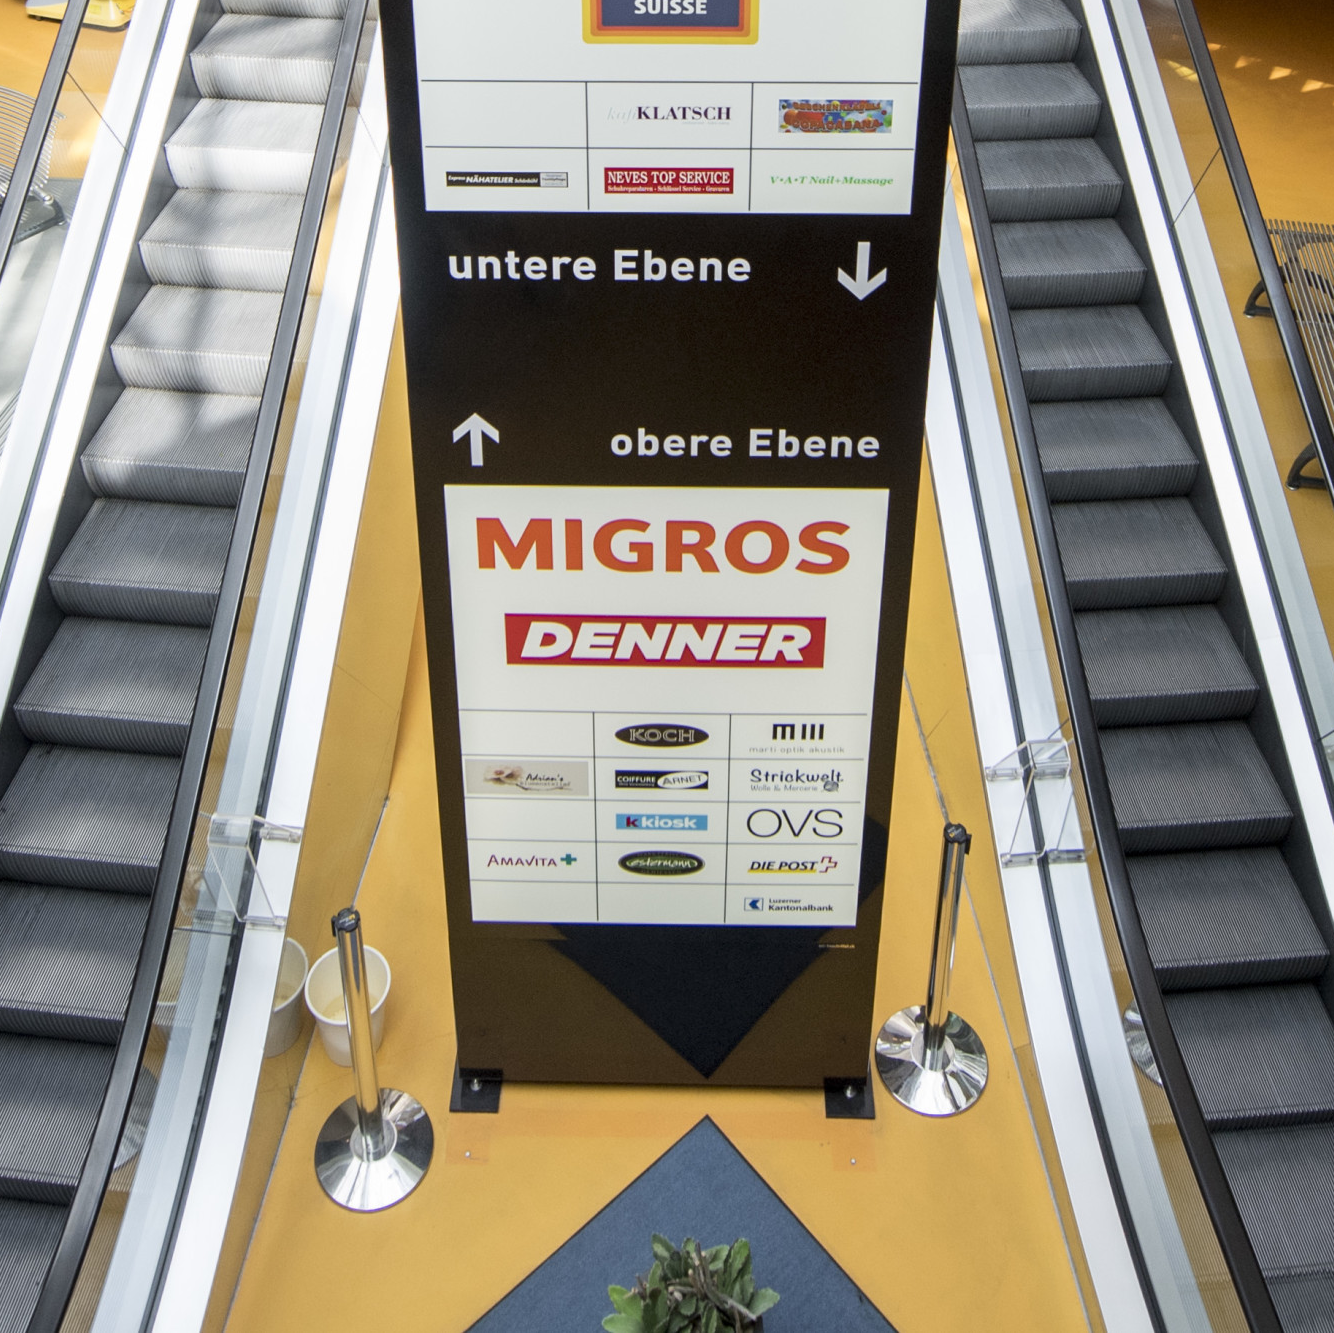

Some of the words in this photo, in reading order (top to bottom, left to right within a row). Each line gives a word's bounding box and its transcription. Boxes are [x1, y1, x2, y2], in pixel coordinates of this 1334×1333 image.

[634, 0, 707, 15] SUISSE
[466, 175, 514, 184] NÄHATELIER
[607, 171, 648, 184] NEVES
[651, 171, 676, 184] TOP
[679, 171, 730, 184] SERVICE
[448, 250, 597, 280] untere
[614, 249, 752, 281] Ebene
[610, 428, 733, 457] obere
[749, 429, 881, 458] Ebene
[476, 517, 851, 574] MIGROS
[520, 621, 812, 662] DENNER
[629, 728, 695, 742] KOCH
[780, 746, 805, 754] optik
[617, 775, 656, 783] COIFFURE
[662, 774, 703, 786] ARNET
[625, 816, 639, 827] k
[641, 815, 697, 828] kiosk
[747, 808, 843, 838] OVS
[750, 861, 776, 871] DIE
[778, 861, 818, 871] POST
[768, 904, 834, 912] Kantonalbank
